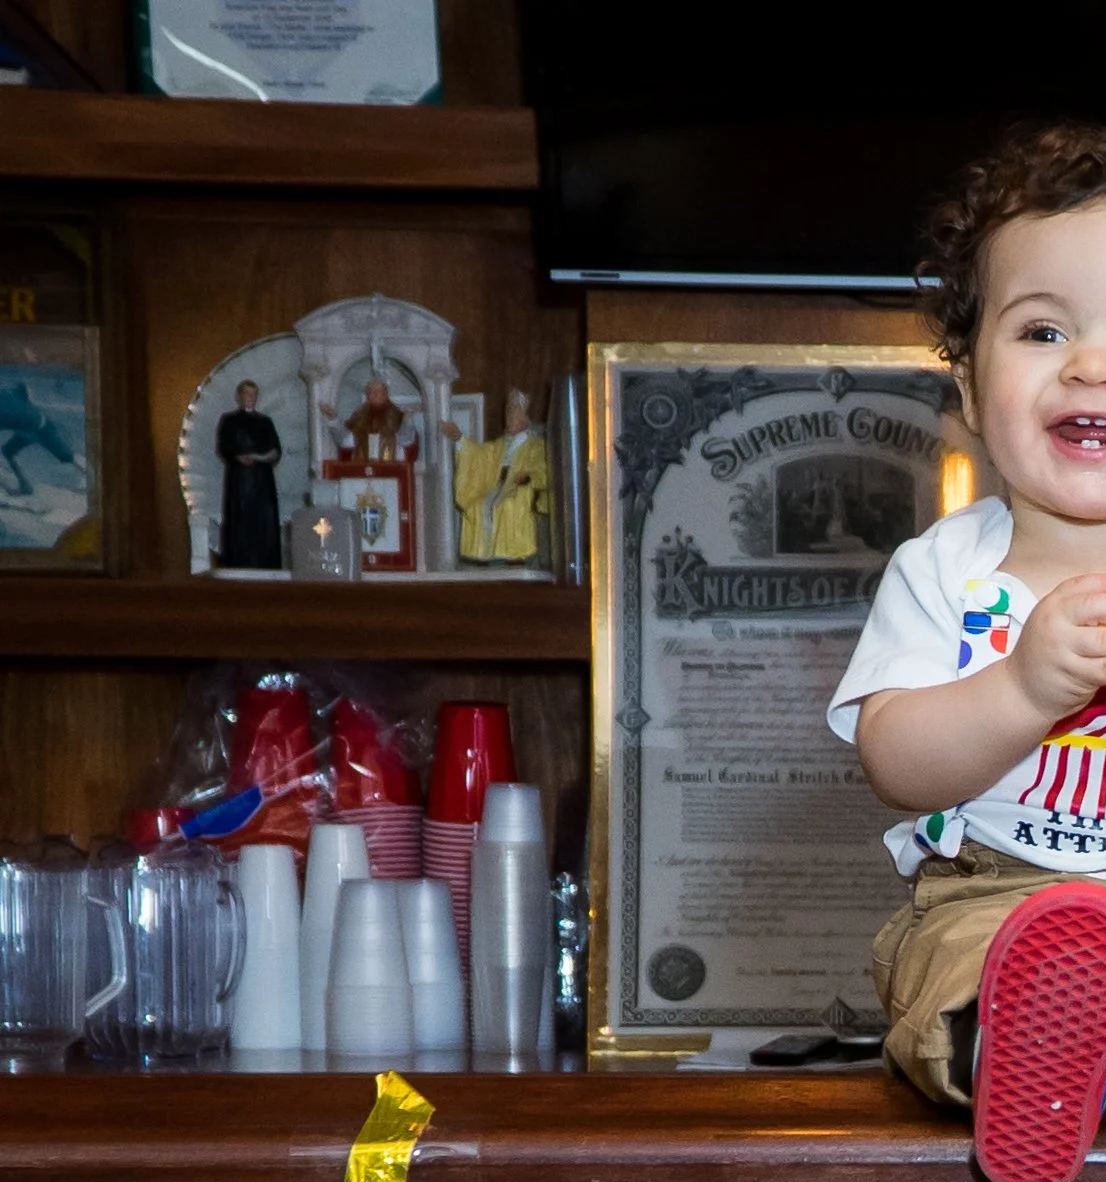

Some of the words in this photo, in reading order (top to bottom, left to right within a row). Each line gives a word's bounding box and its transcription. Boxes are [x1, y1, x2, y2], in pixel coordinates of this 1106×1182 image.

[701, 410, 839, 481] SUPREME
[658, 551, 805, 613] KNIGHTS
[811, 575, 848, 607] OF
